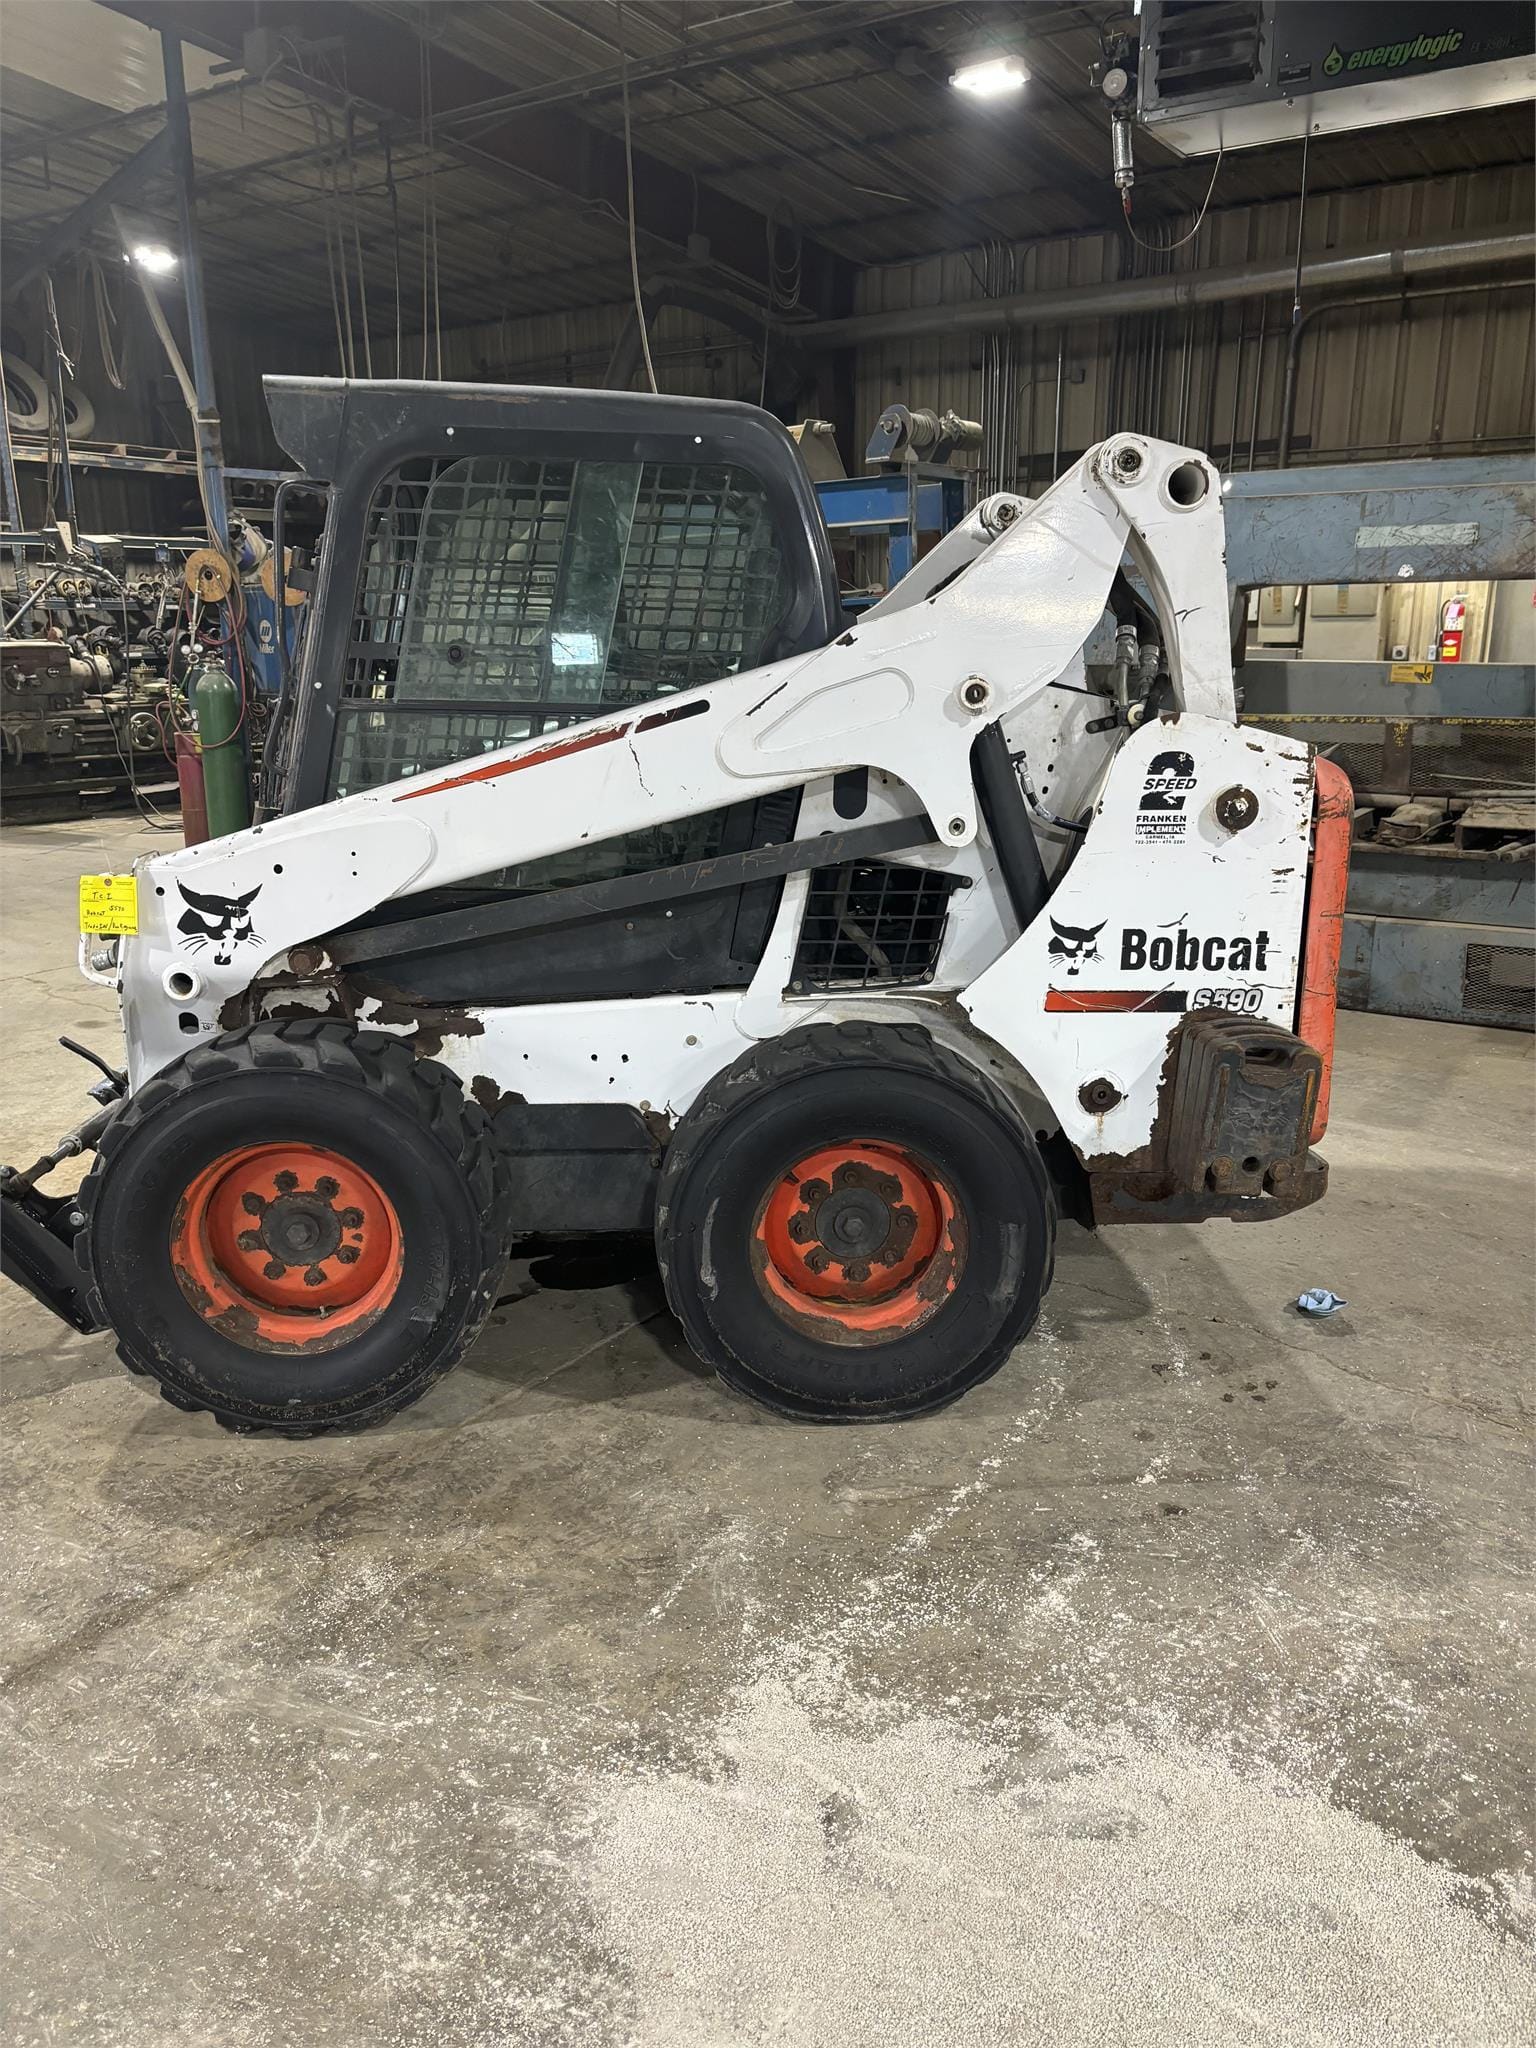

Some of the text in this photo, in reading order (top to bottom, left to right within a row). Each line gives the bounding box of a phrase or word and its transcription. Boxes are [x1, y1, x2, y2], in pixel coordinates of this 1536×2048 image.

[1346, 28, 1464, 70] energylogic
[1143, 778, 1198, 790] SPEED
[1136, 815, 1187, 823] FRANKEN
[1120, 928, 1270, 971] Bobcat
[1193, 988, 1263, 1013] S590
